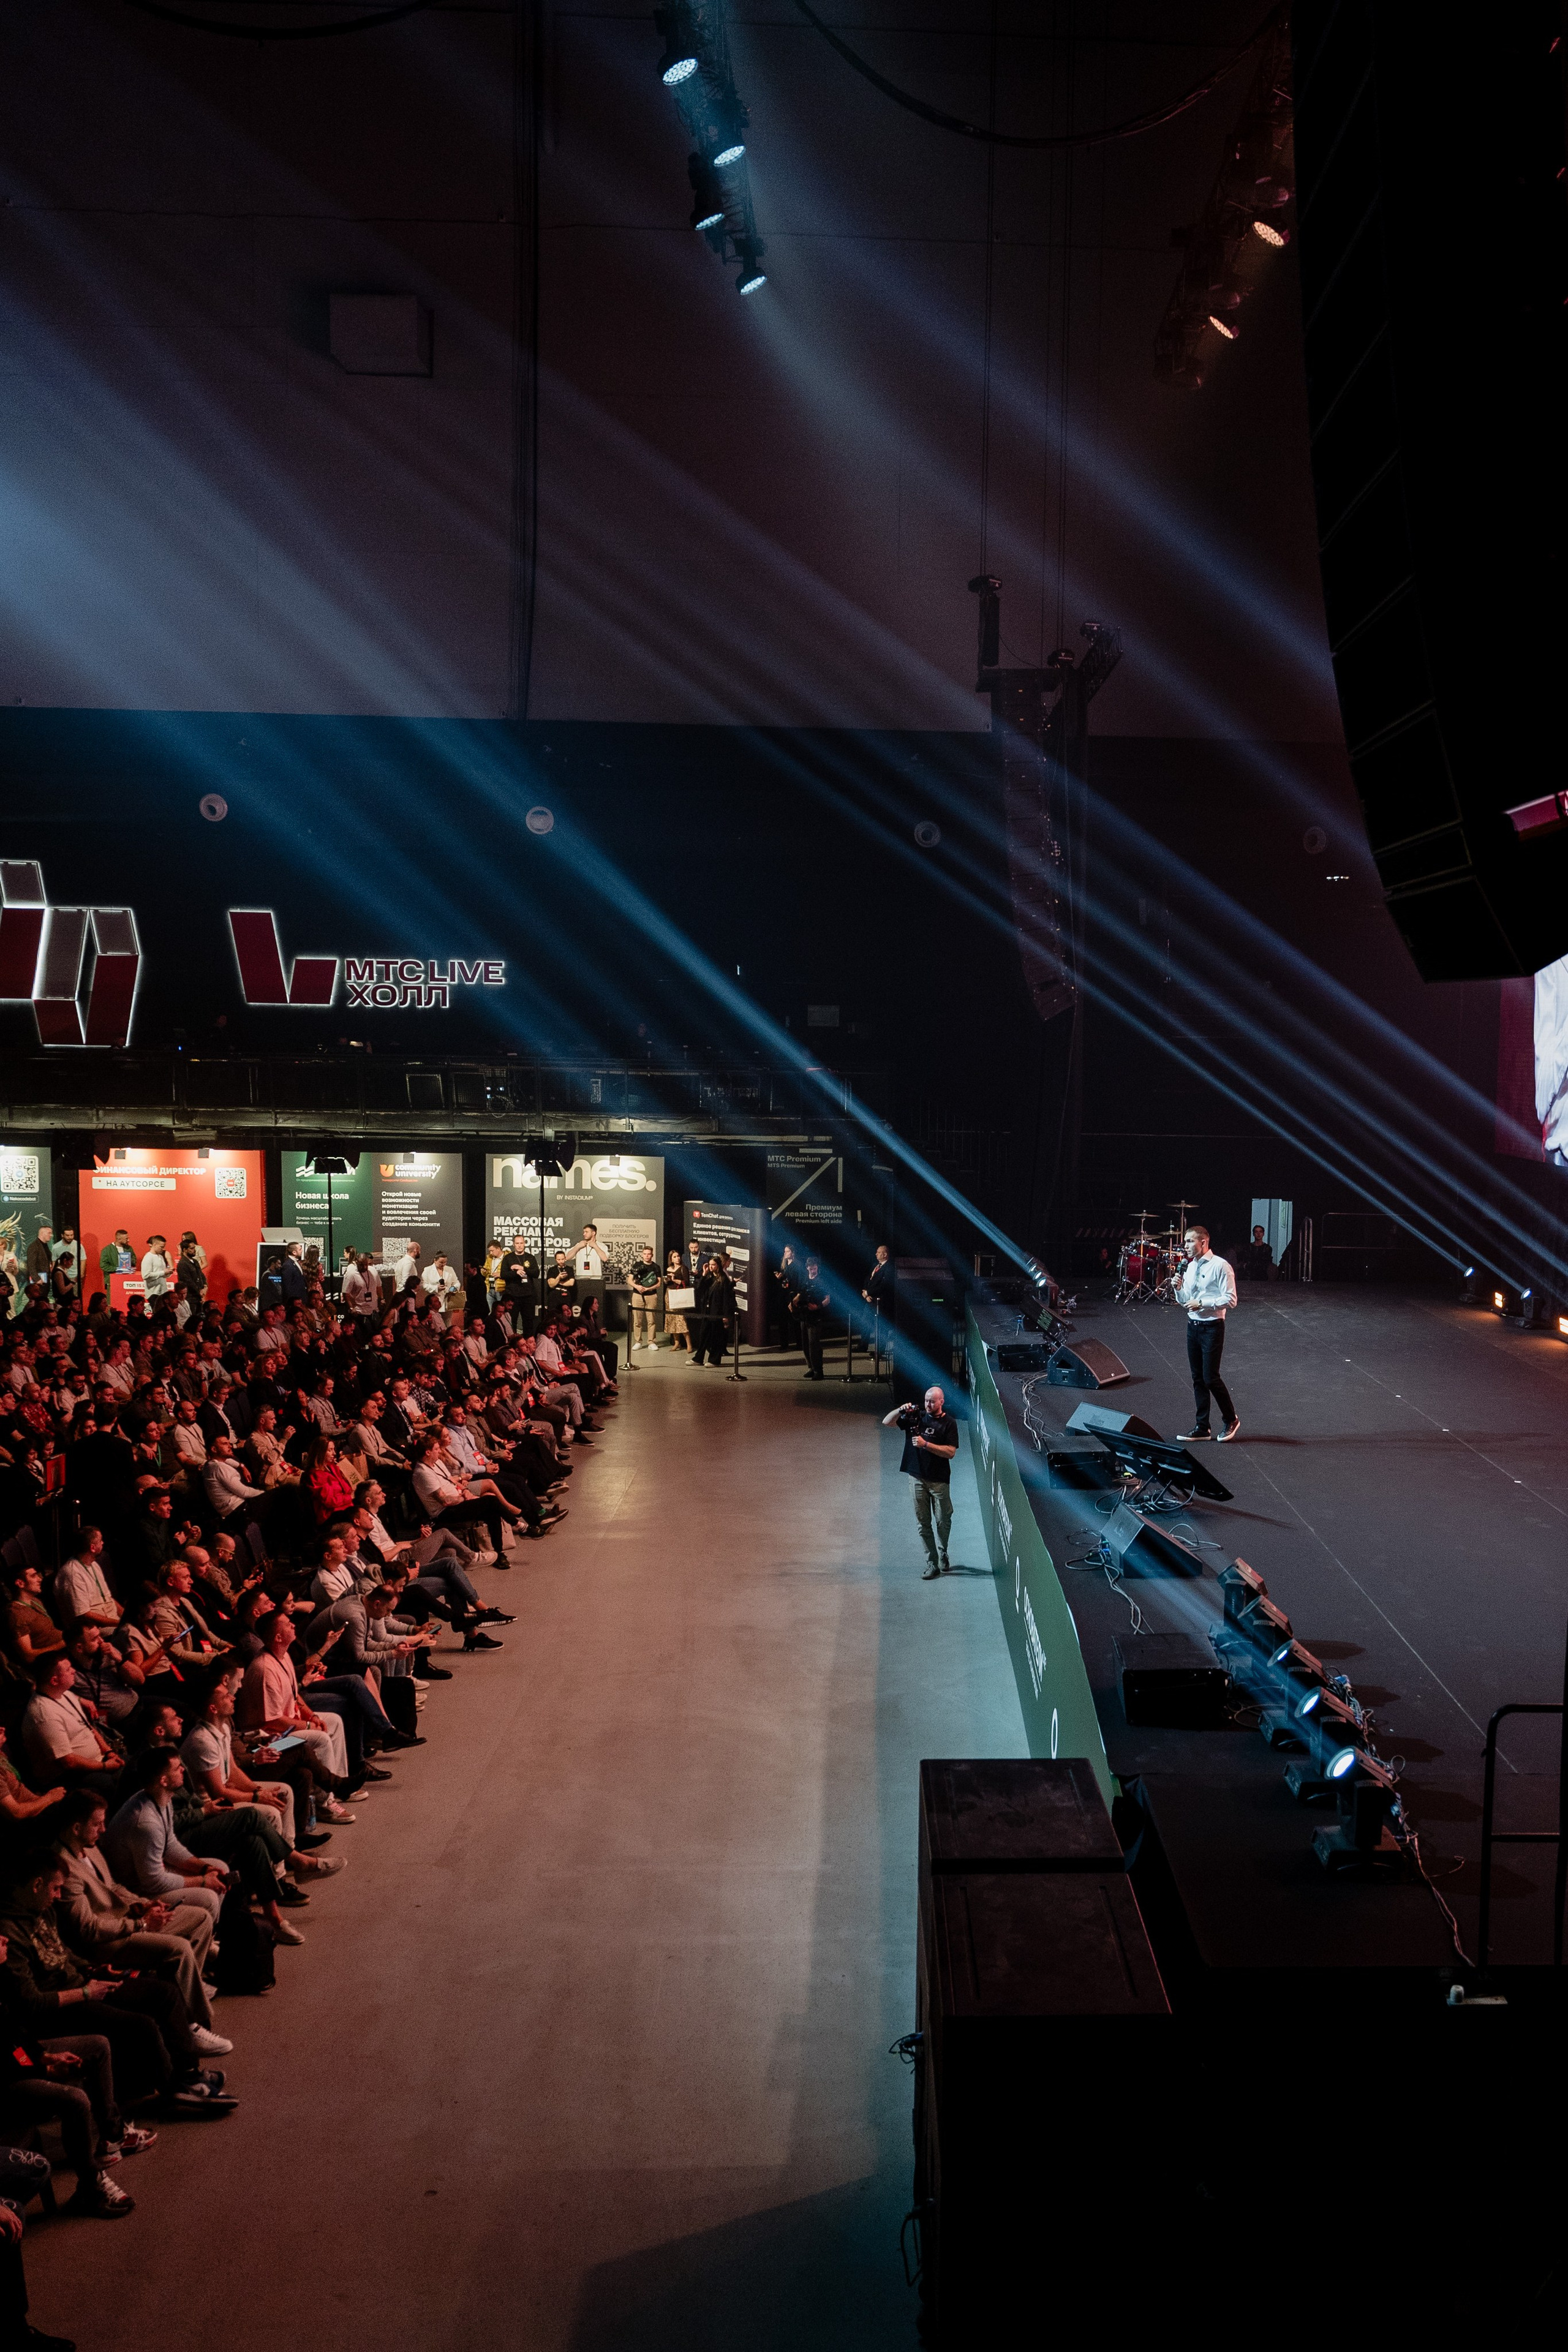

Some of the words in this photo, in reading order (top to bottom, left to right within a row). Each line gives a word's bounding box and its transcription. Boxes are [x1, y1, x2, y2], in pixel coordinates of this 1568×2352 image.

[345, 959, 424, 982] МТС
[428, 960, 505, 984] LIVE
[346, 983, 449, 1008] ХОЛЛ
[159, 1167, 206, 1175] ДИРЕКТОР
[395, 1164, 441, 1173] community
[395, 1170, 437, 1179] university
